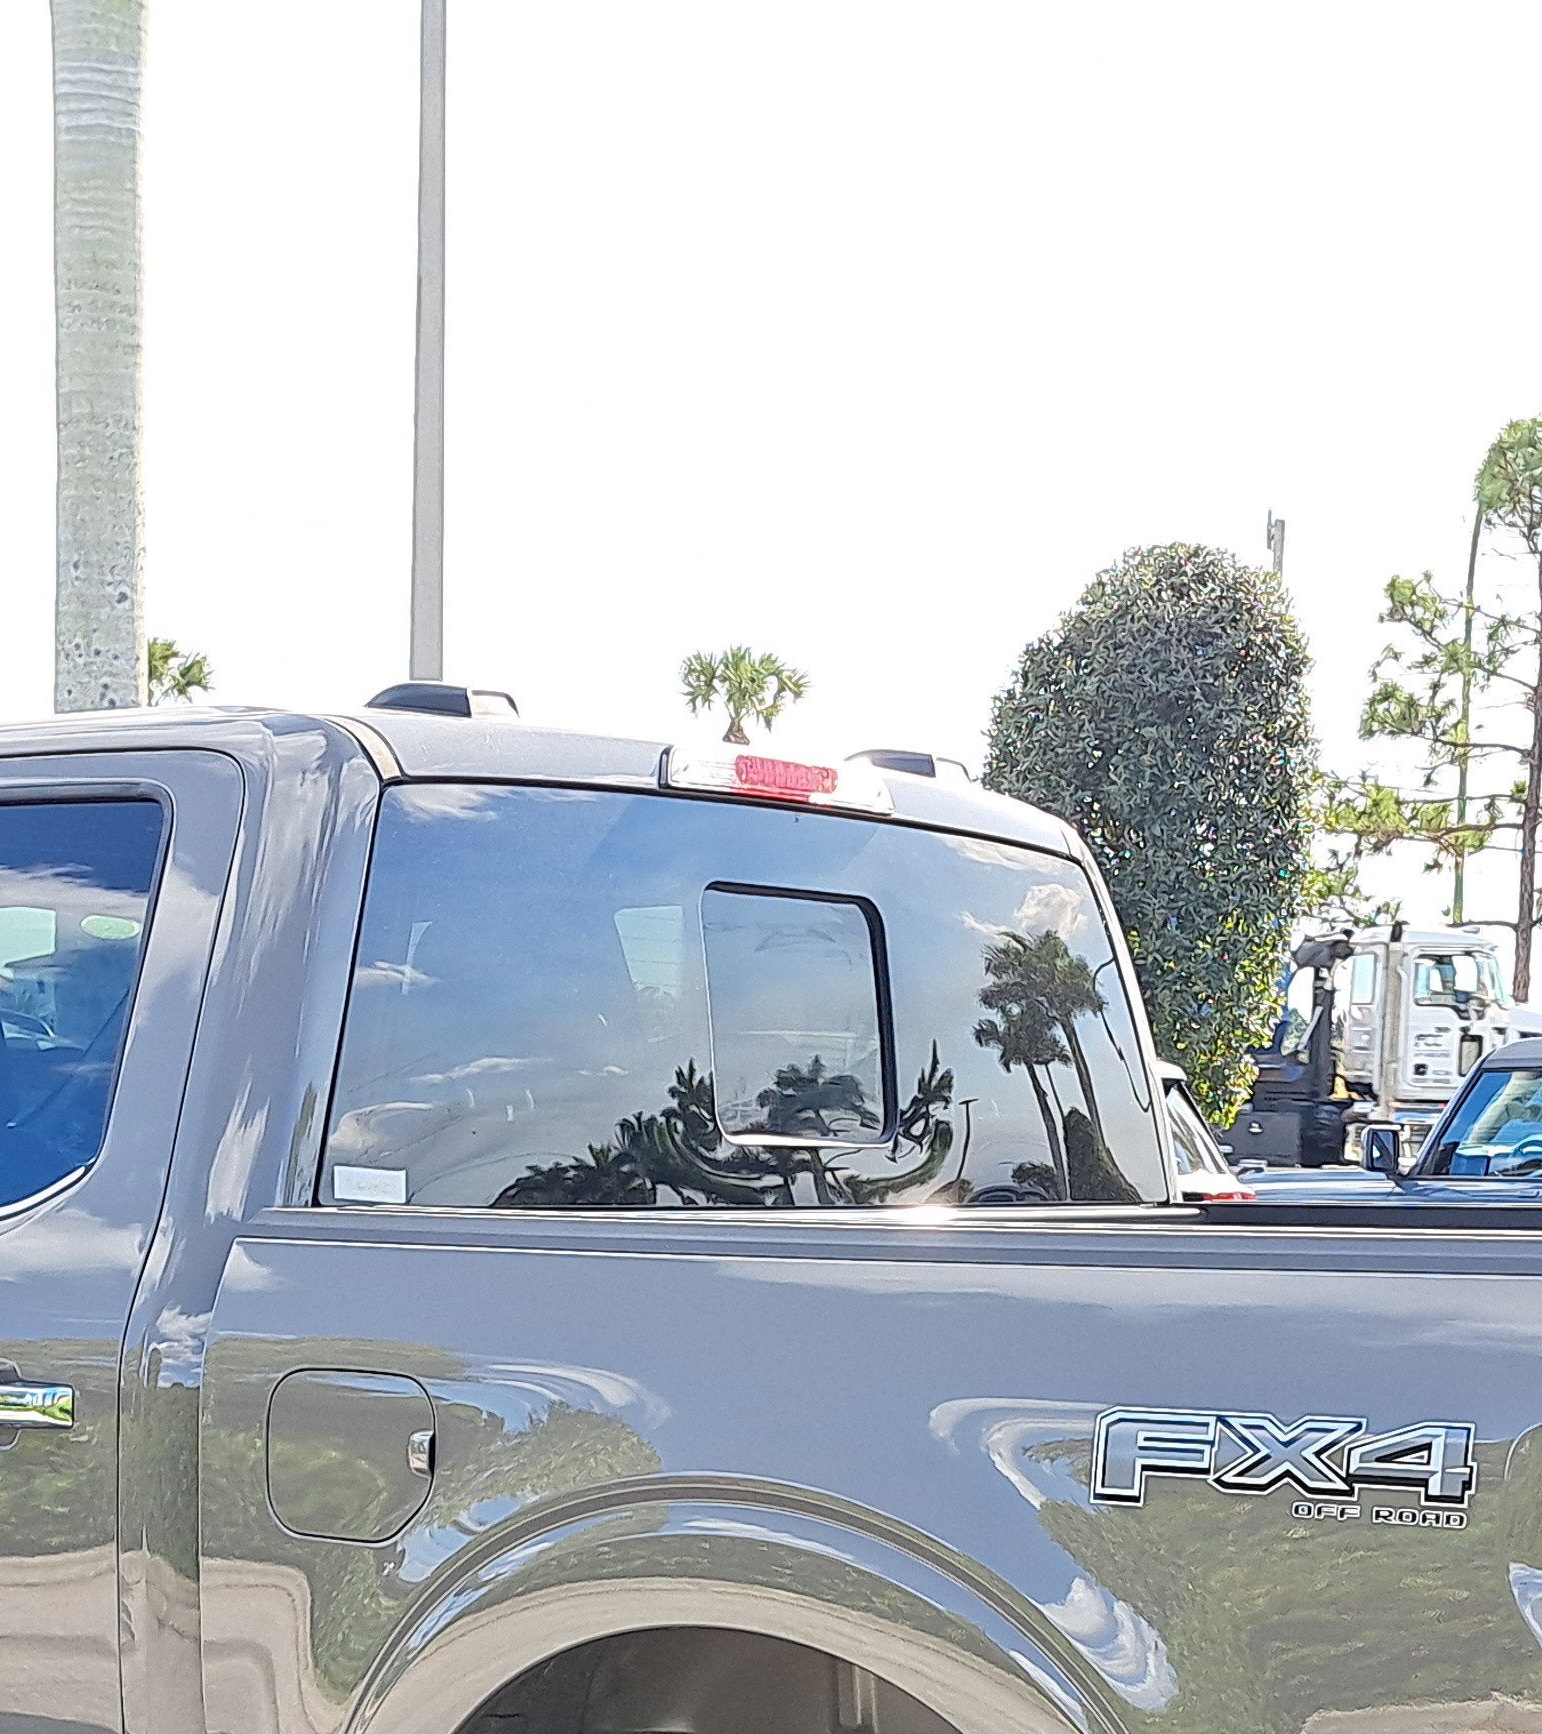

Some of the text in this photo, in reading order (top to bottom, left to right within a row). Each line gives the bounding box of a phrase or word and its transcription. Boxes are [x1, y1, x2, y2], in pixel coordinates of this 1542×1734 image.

[1090, 1406, 1477, 1508] FX4
[1291, 1501, 1468, 1530] OFF ROAD
